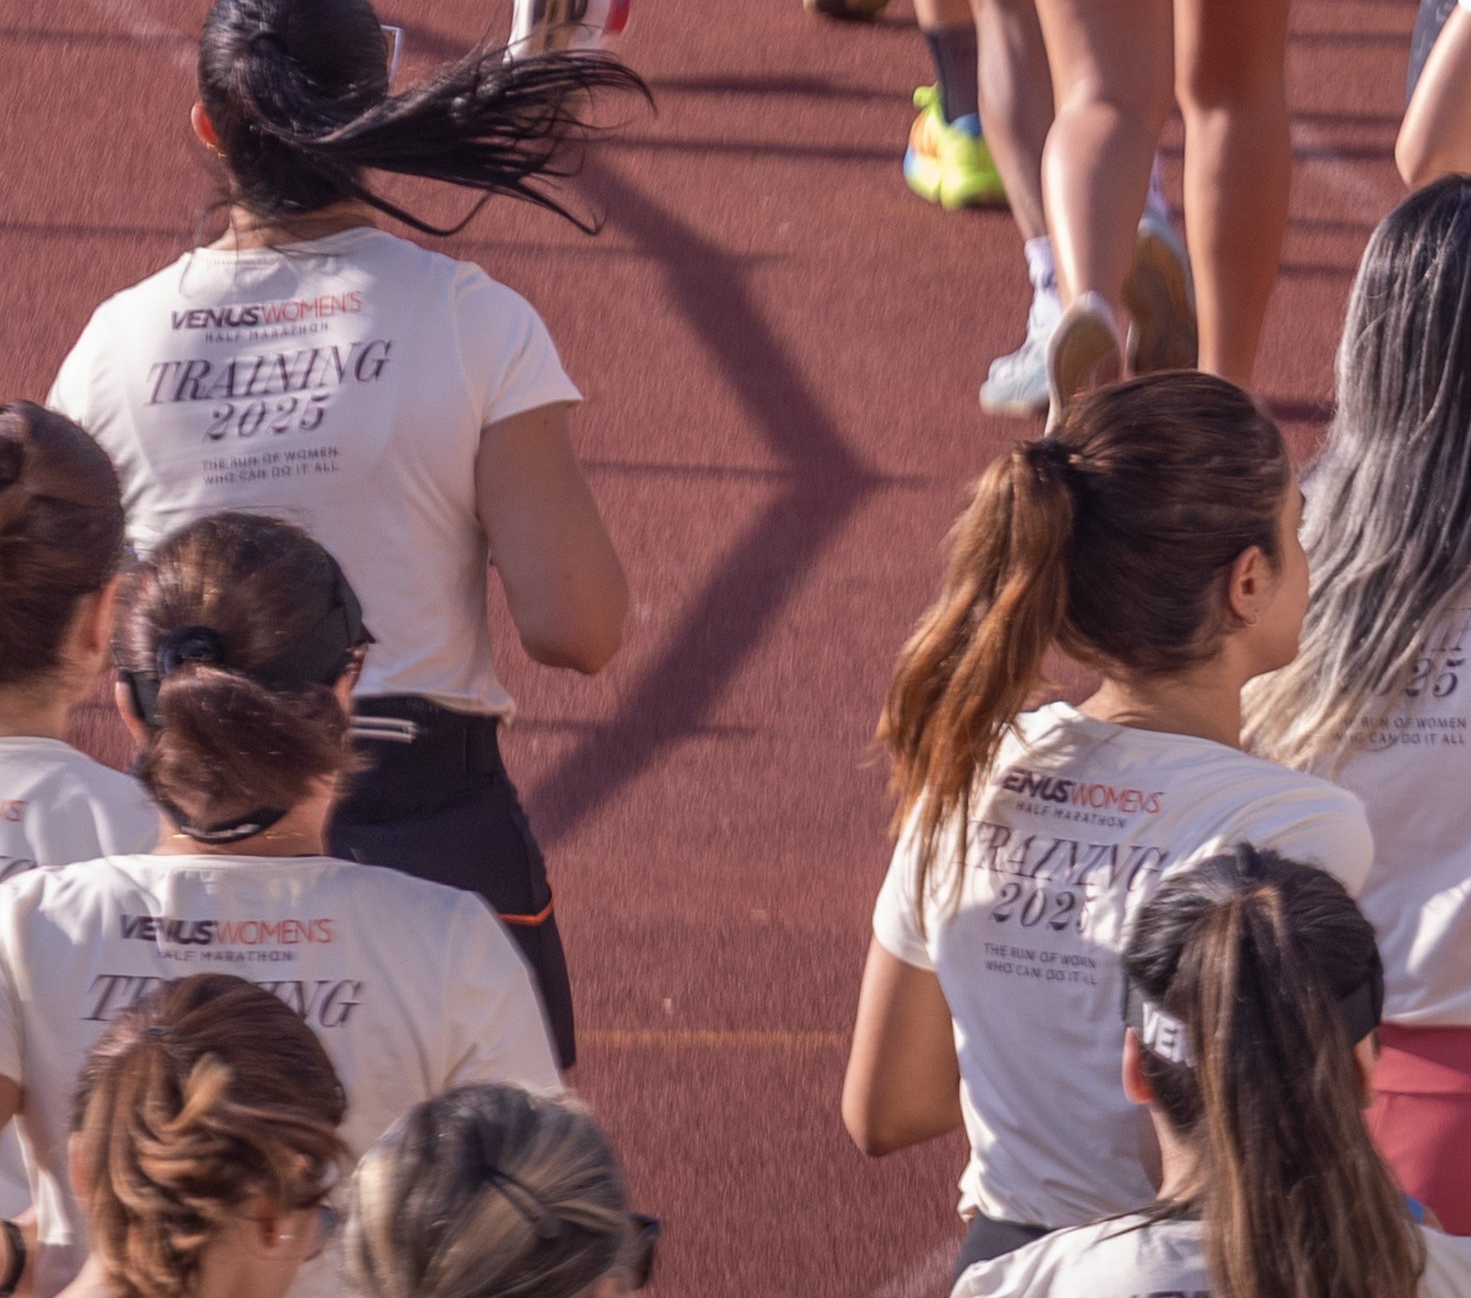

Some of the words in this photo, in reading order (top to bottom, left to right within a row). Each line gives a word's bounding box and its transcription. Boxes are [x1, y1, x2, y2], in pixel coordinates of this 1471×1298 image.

[145, 338, 393, 405] TRAINING
[201, 393, 338, 441] 2025
[283, 446, 339, 462] WOMEN
[313, 461, 340, 473] ALL
[1417, 717, 1467, 729] WOMEN
[1424, 733, 1437, 744] IT
[1443, 733, 1465, 744] ALL
[1014, 799, 1051, 819] HALF
[1053, 803, 1127, 829] MARATHON
[199, 950, 294, 963] MARATHON
[984, 942, 1008, 956] THE
[1010, 947, 1035, 961] RUN
[1039, 951, 1057, 963] OF
[1016, 964, 1042, 978] CAN
[1045, 969, 1065, 981] DO
